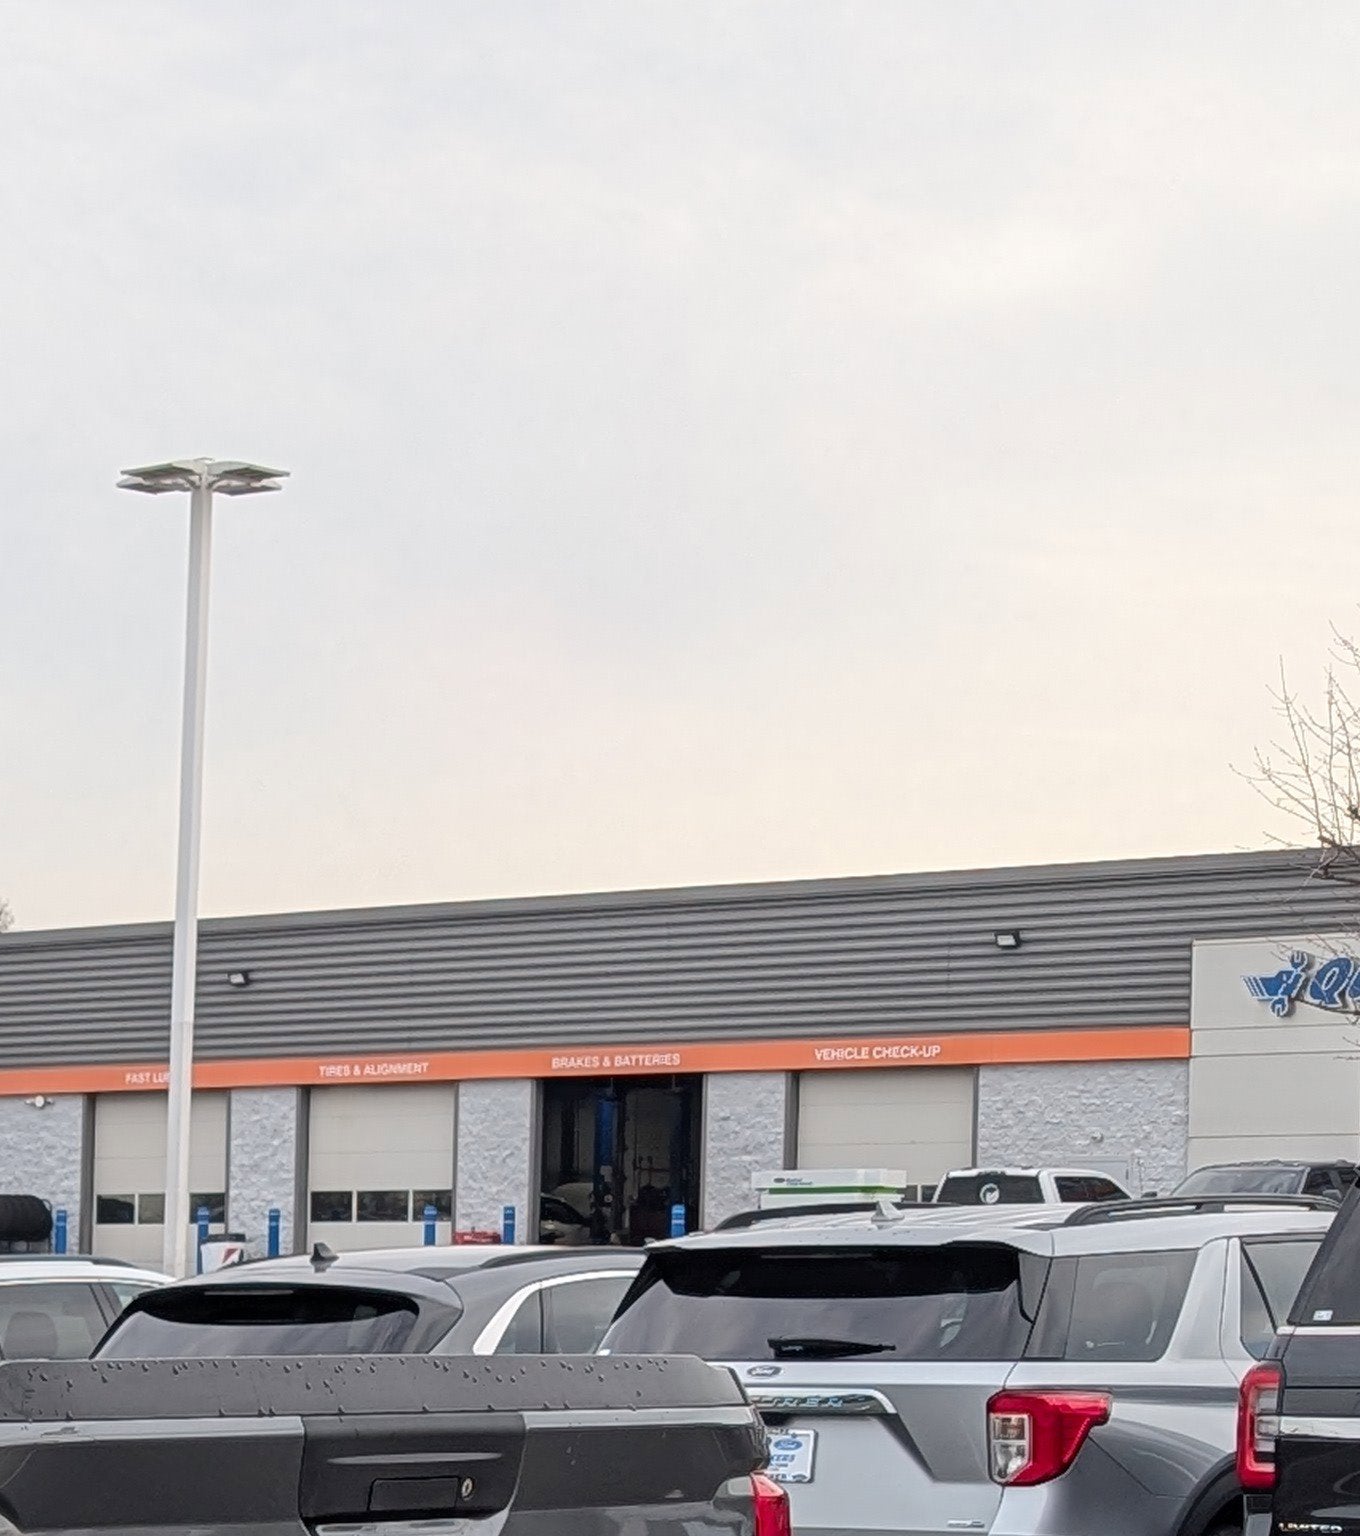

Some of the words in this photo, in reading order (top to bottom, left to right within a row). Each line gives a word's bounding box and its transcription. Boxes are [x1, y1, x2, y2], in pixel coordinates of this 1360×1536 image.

[814, 1046, 870, 1060] VEHICLE
[872, 1045, 941, 1059] CHECK-UP
[551, 1056, 599, 1070] BRAKES
[602, 1056, 611, 1068] &
[614, 1053, 680, 1067] BATTERIES
[125, 1071, 151, 1084] FAST
[318, 1065, 351, 1078] TIRES
[353, 1065, 361, 1077] &
[363, 1062, 429, 1076] ALIGNMENT
[1279, 1522, 1343, 1534] LIMITED
